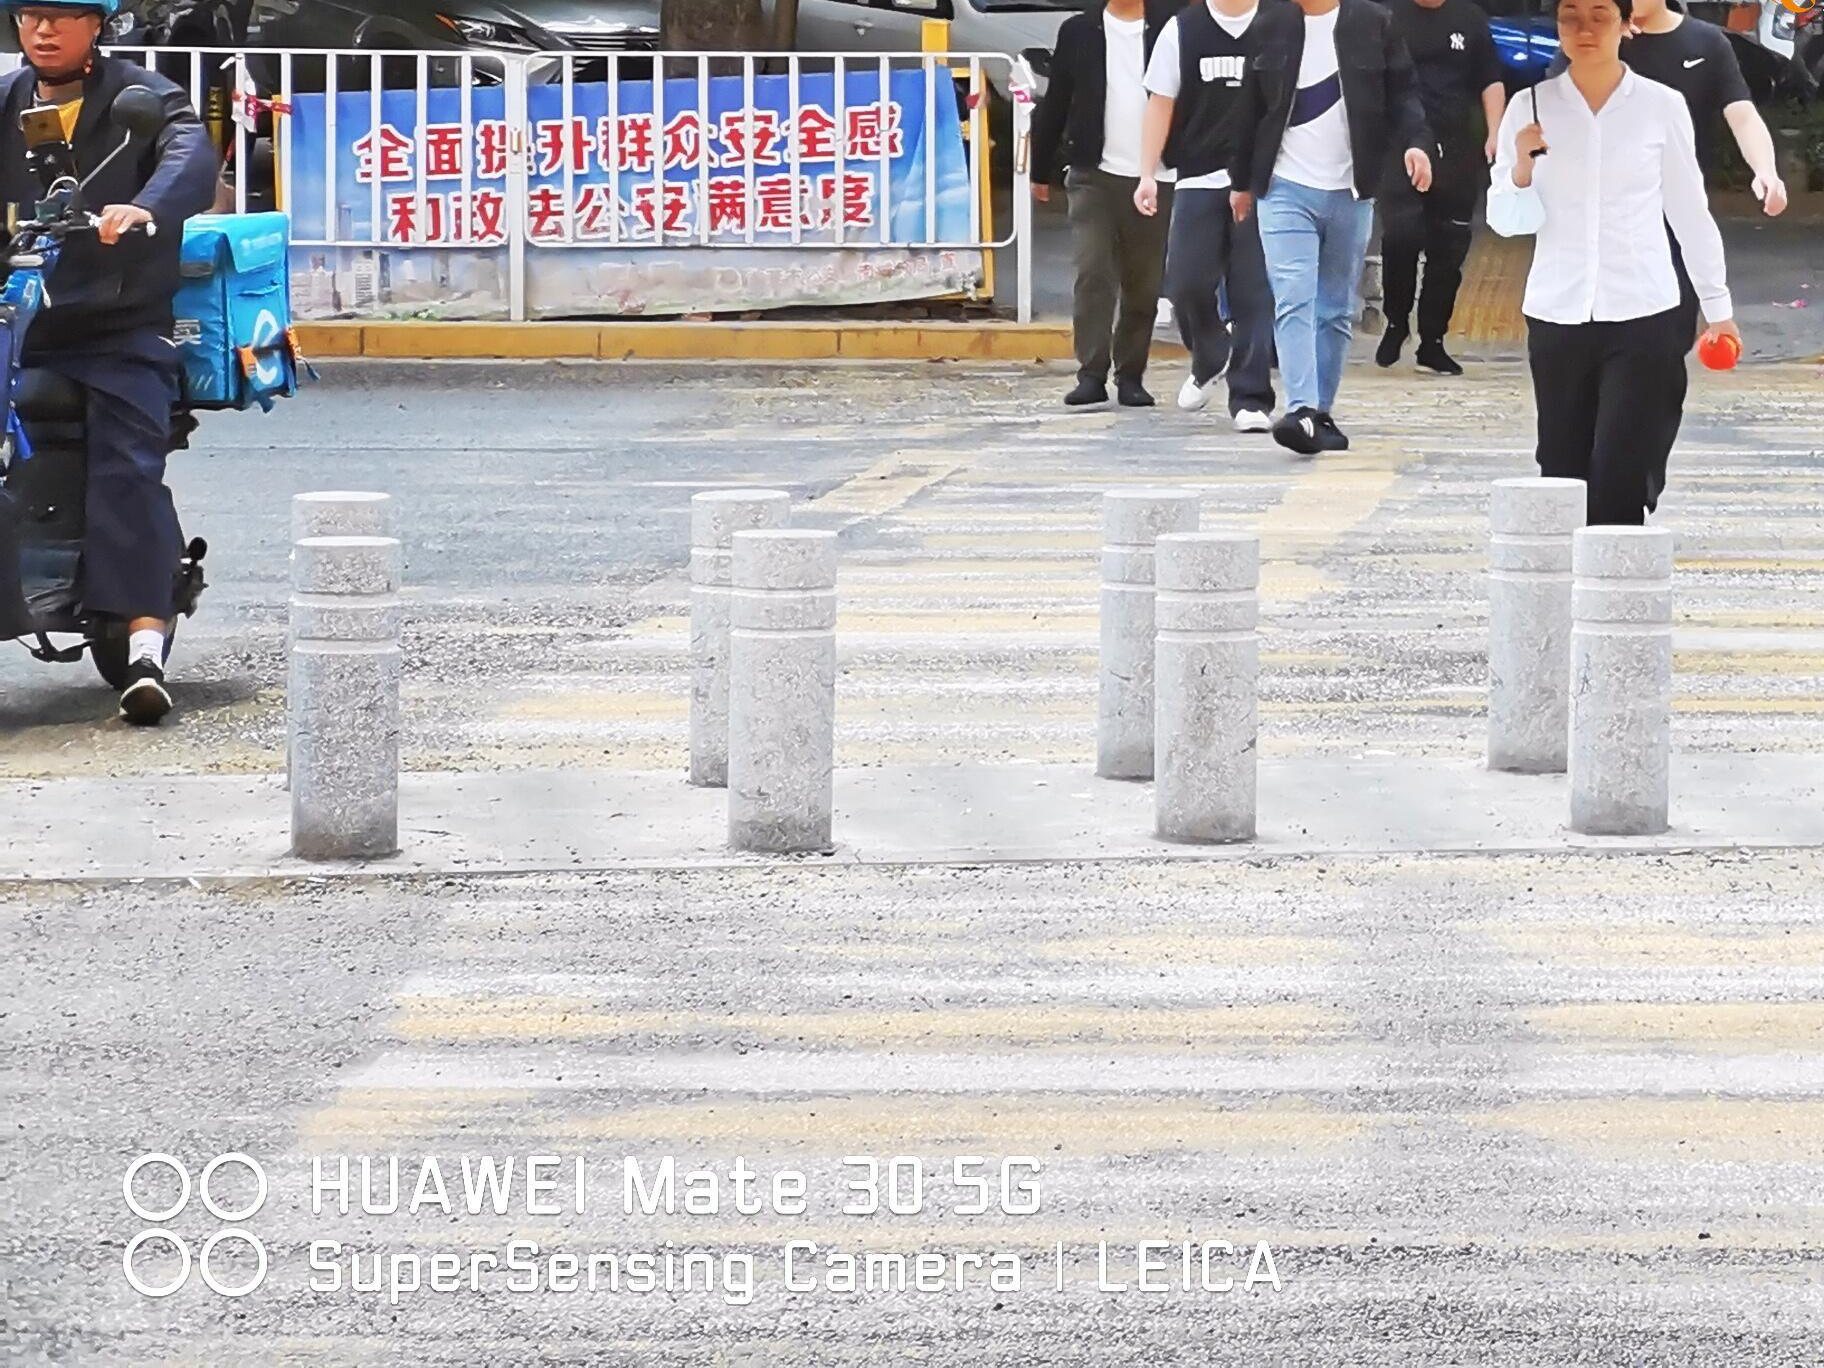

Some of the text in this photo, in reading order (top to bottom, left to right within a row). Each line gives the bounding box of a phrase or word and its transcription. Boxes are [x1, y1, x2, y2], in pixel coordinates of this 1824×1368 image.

[354, 103, 902, 181] 全面提升群众安全感
